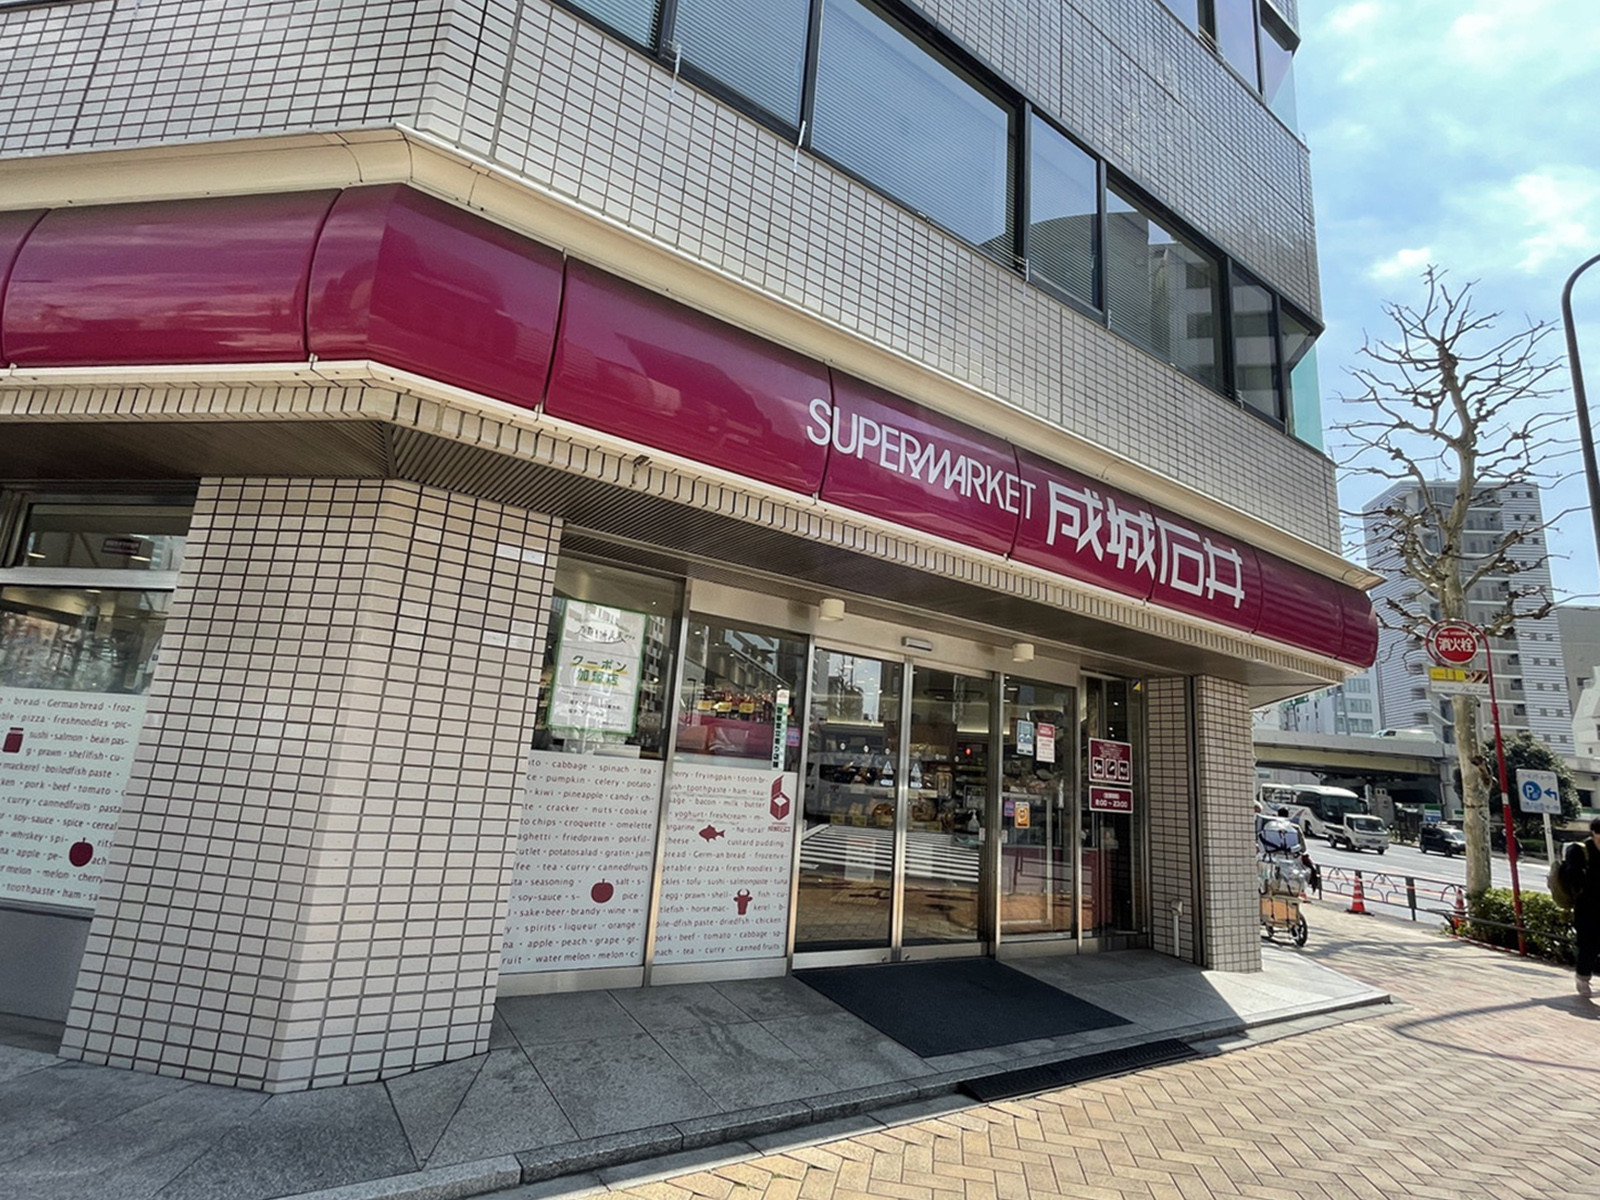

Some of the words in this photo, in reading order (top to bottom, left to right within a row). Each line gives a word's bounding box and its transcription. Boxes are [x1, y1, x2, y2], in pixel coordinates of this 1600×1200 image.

[806, 398, 1036, 519] SUPERMARKET
[1046, 479, 1245, 609] 成城石井
[1438, 638, 1474, 652] 消火栓
[573, 655, 627, 672] クーポン
[14, 697, 40, 706] bread
[47, 699, 78, 708] German
[80, 701, 104, 710] bread
[21, 715, 45, 723] pizza
[55, 732, 82, 740] salmon
[90, 735, 109, 743] bean
[3, 762, 39, 771] mackerel
[88, 769, 111, 778] paste
[552, 761, 587, 770] cabbage
[546, 775, 585, 783] pumpkin
[24, 781, 44, 789] pork
[52, 782, 70, 791] beef
[79, 786, 111, 795] tomato
[563, 790, 603, 799] pineapple
[610, 793, 633, 801] candy
[8, 796, 29, 806] curry
[99, 804, 121, 813] pasta
[546, 804, 579, 812] cracker
[592, 806, 612, 814] nuts
[620, 807, 647, 815] cookie
[675, 811, 703, 819] yoghurt
[13, 813, 54, 825] soy-sauce
[63, 818, 83, 828] spice
[92, 821, 117, 830] cereal
[532, 818, 556, 826] chips
[564, 818, 606, 828] croquette
[616, 821, 652, 829] omelette
[11, 830, 42, 840] whiskey
[756, 840, 784, 848] pudding
[16, 847, 40, 858] apple
[548, 848, 598, 857] potatosalad
[605, 849, 630, 858] gratin
[635, 850, 651, 858] jam
[6, 866, 31, 875] melon
[43, 869, 69, 879] melon
[7, 883, 54, 896] toothpaste
[62, 889, 81, 898] ham
[518, 894, 561, 902] soy-sauce
[622, 892, 638, 900] pice
[524, 924, 556, 932] spirits
[564, 923, 597, 932] liqueur
[608, 922, 636, 930] orange
[694, 919, 713, 927] paste
[527, 940, 552, 948] apple
[561, 938, 587, 946] peach
[595, 937, 619, 946] grape
[705, 946, 725, 954] curry
[536, 954, 561, 962] water
[564, 952, 590, 961] melon
[598, 951, 624, 959] melon
